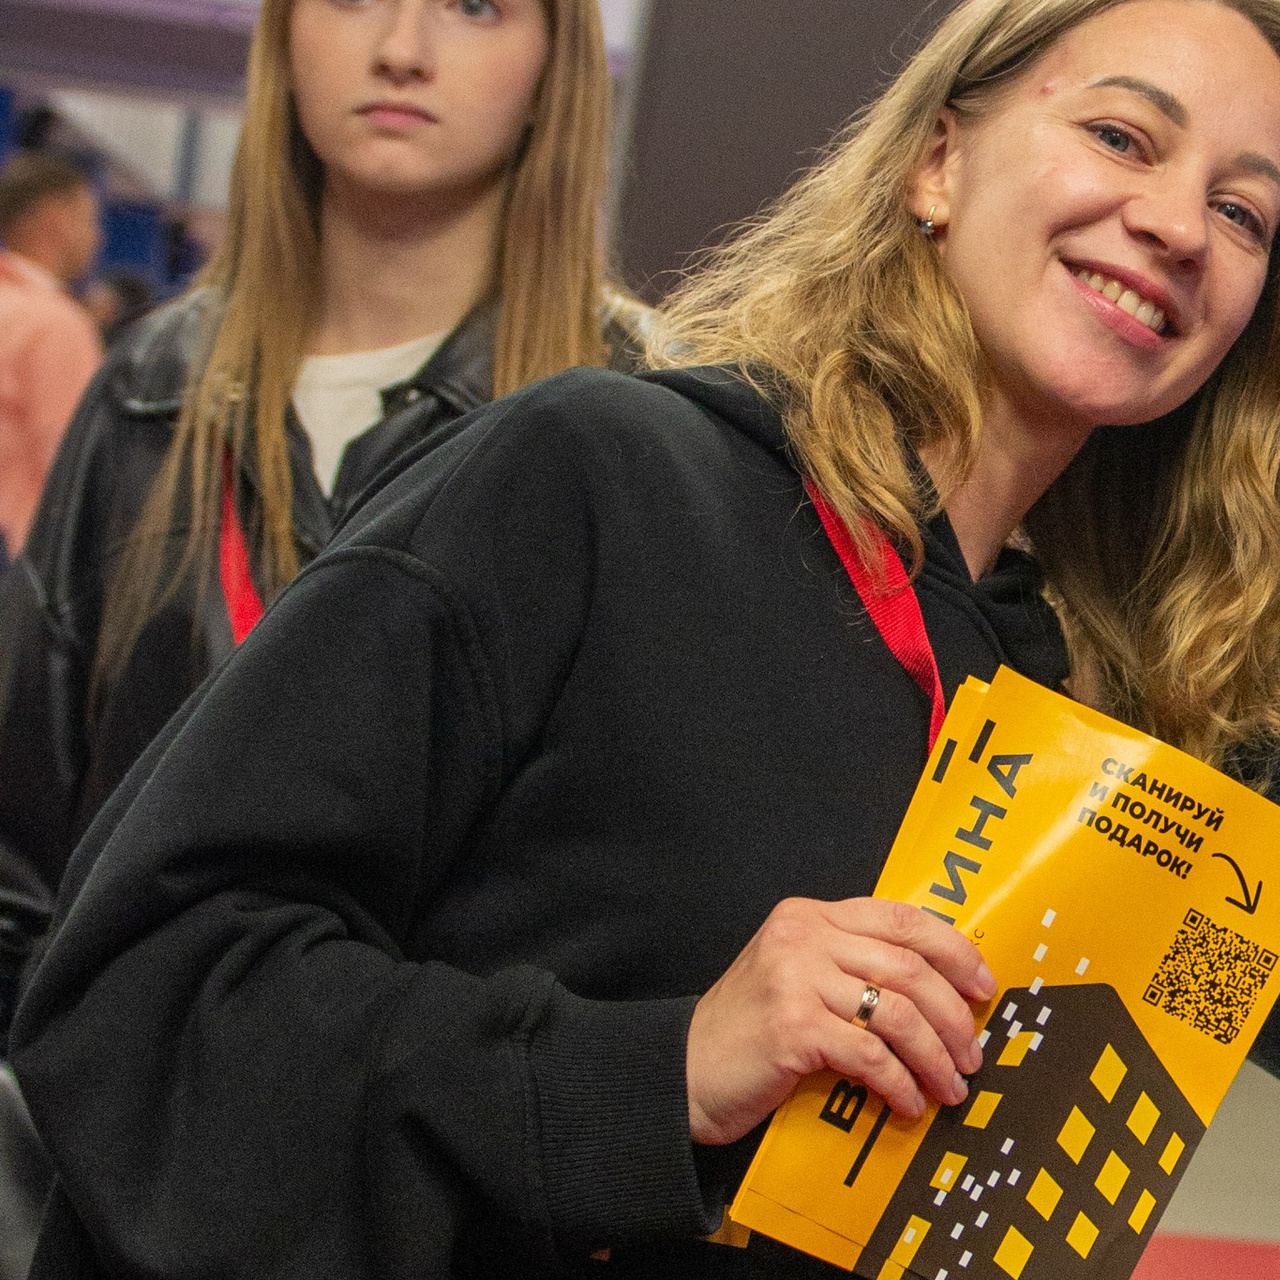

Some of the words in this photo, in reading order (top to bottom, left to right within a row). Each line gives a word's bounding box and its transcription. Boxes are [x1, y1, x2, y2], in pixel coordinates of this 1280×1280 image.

[1089, 781, 1110, 802] И
[1111, 792, 1204, 853] ПОЛУЧИ
[1101, 758, 1224, 832] СКАНИРУЙ
[1077, 807, 1193, 880] ПОДАРОК!
